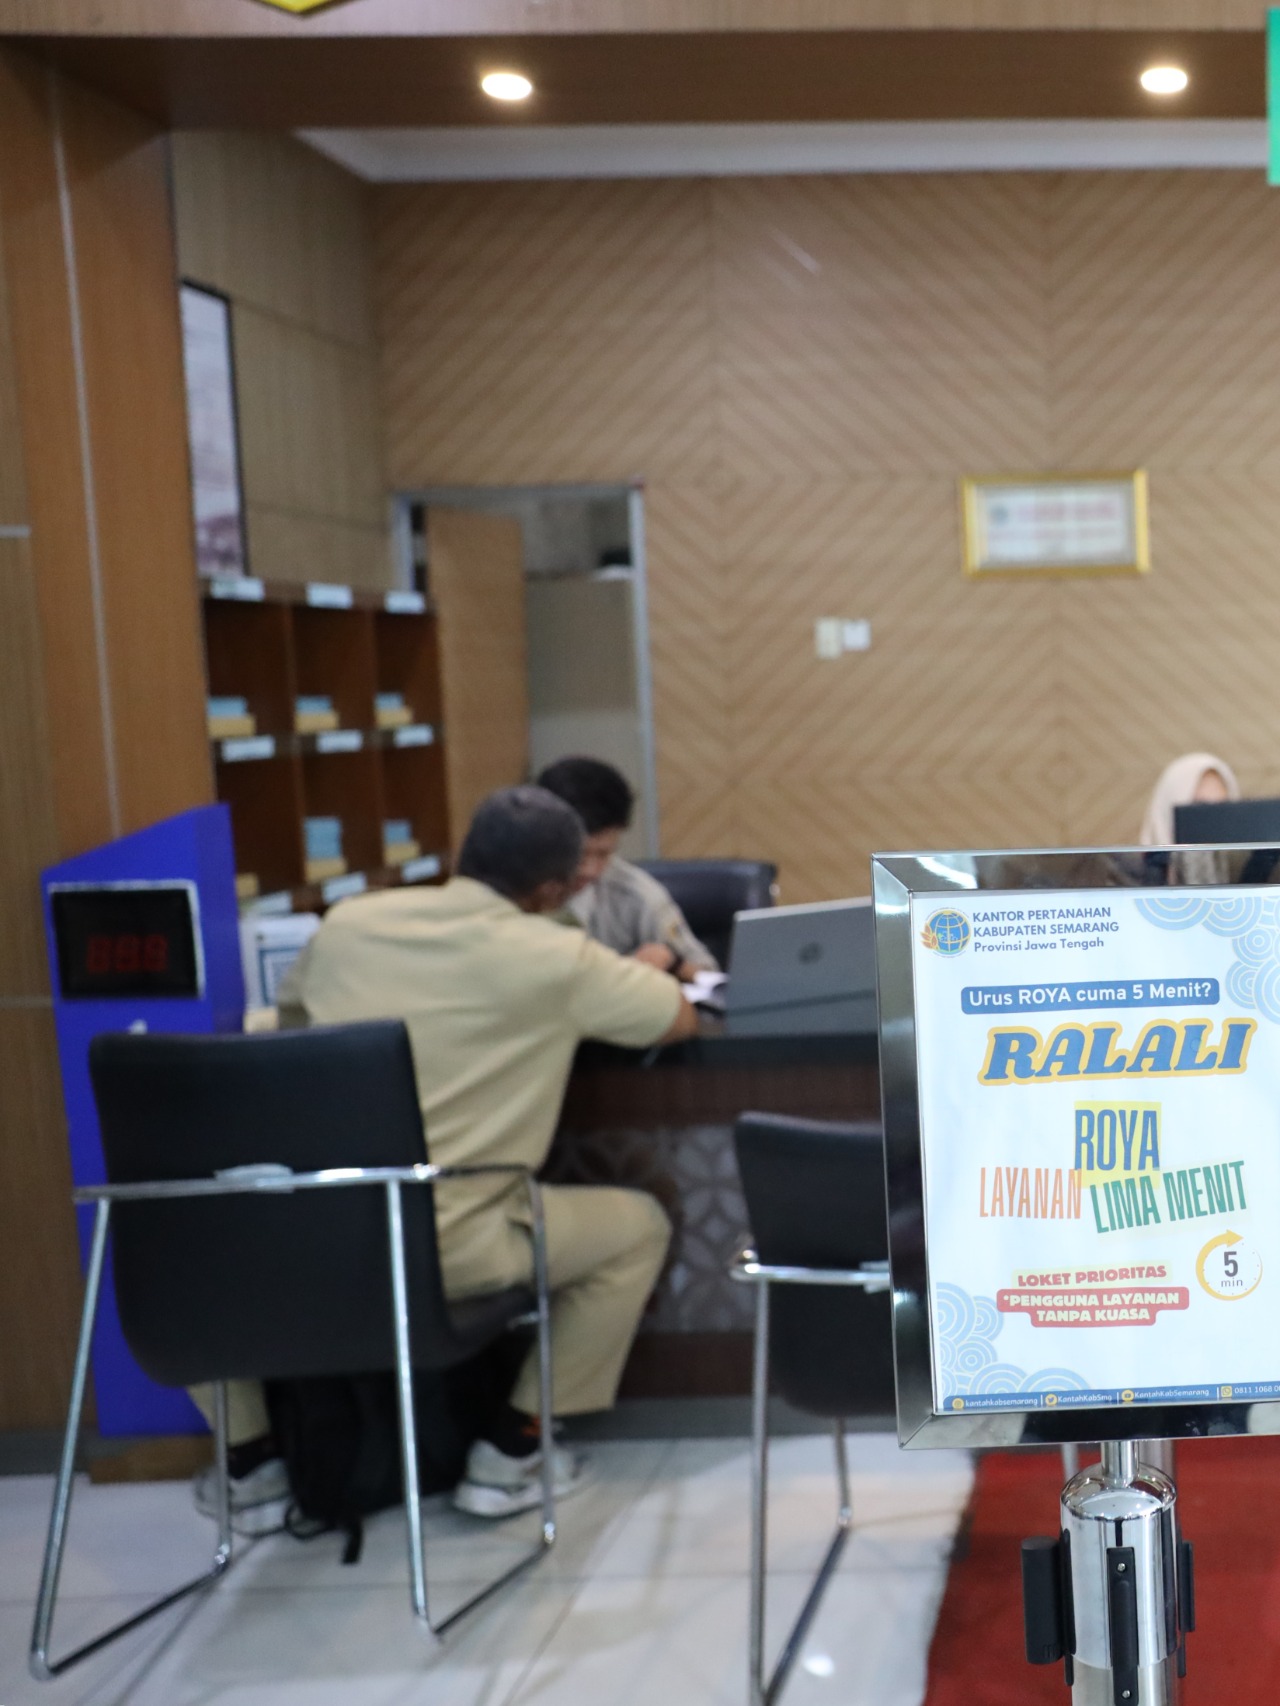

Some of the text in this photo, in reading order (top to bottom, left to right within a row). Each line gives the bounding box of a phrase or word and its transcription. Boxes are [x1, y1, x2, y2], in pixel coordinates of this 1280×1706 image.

[972, 907, 1111, 922] KANTOR PERTANAHAN
[973, 924, 1046, 937] KABUPATEN
[1050, 921, 1119, 934] SEMARANG
[974, 937, 1104, 952] Provinsi Jawa Tengah
[969, 982, 1212, 1006] Urus ROYA cuma 5 Menit?
[979, 1019, 1255, 1084] RALALI
[1074, 1109, 1160, 1171] ROYA
[979, 1166, 1082, 1219] LAYANAN
[1090, 1160, 1247, 1234] LIMA MENIT
[1223, 1251, 1239, 1278] 5
[1017, 1265, 1167, 1287] LOKET PRIORITAS
[1221, 1277, 1243, 1287] min
[1103, 1292, 1180, 1305] LAYANAN
[1036, 1308, 1150, 1322] TANPA KUASA
[1234, 1386, 1252, 1395] 0811
[965, 1398, 1038, 1408] kantahkabsemarang
